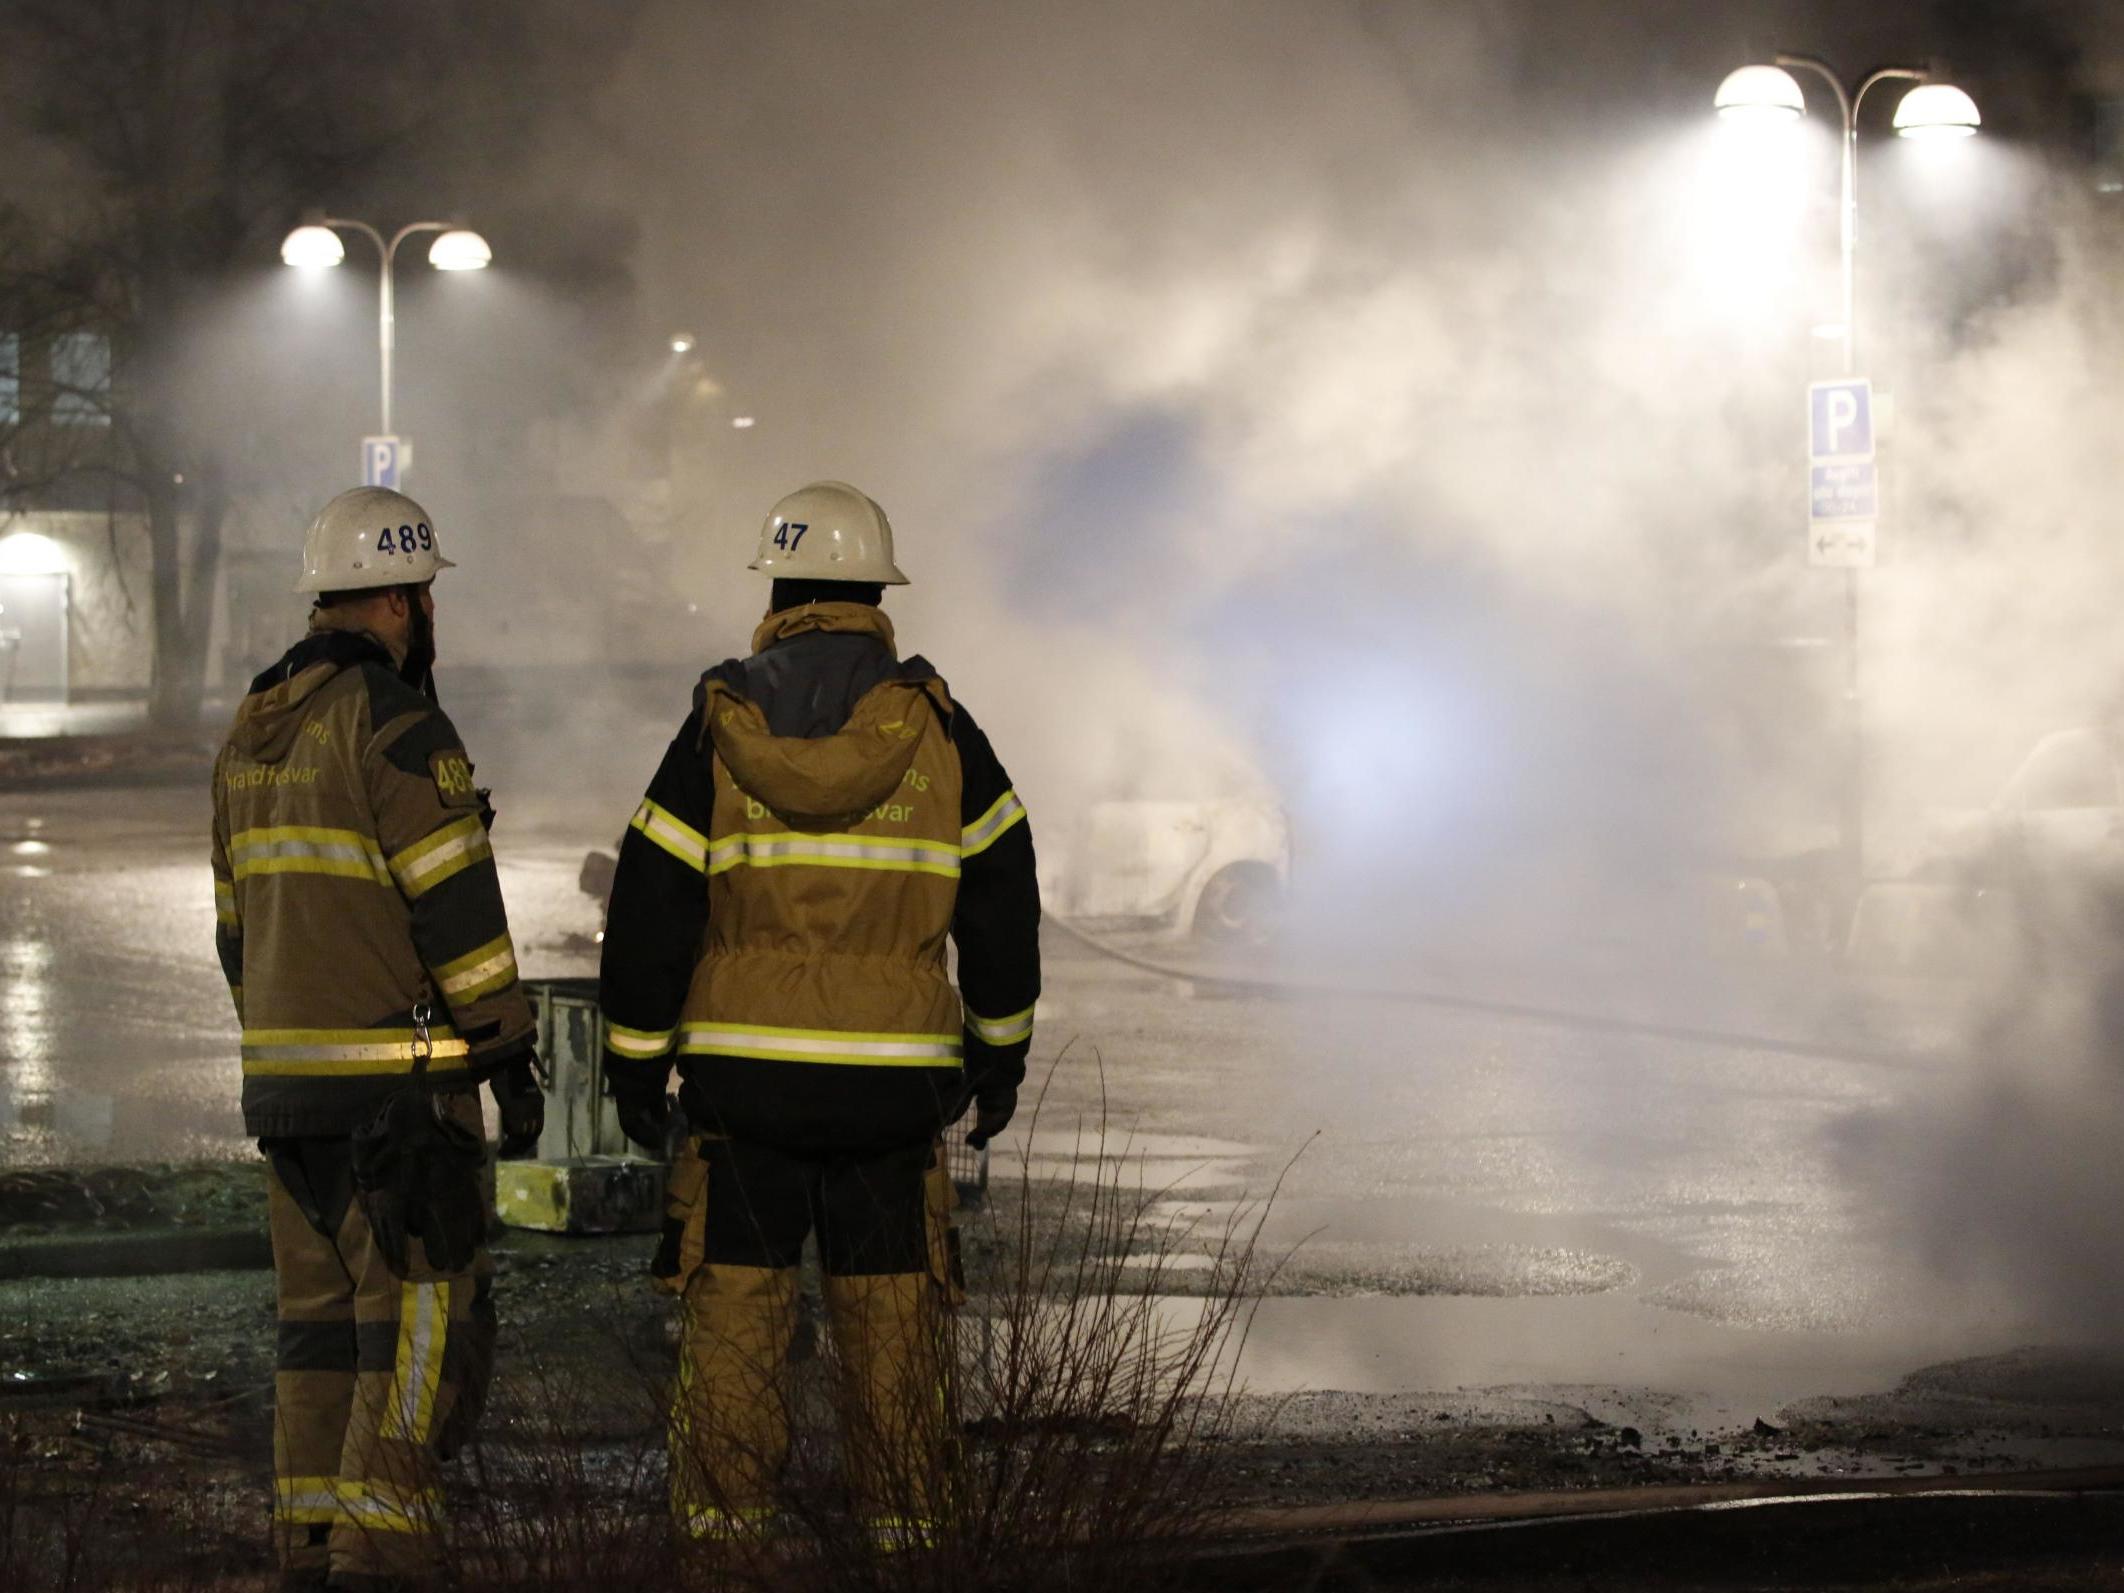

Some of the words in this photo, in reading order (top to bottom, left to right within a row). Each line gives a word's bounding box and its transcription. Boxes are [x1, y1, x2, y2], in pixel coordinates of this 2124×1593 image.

[1827, 389, 1857, 451] P
[373, 445, 392, 487] P
[377, 523, 432, 555] 489
[774, 523, 808, 551] 47
